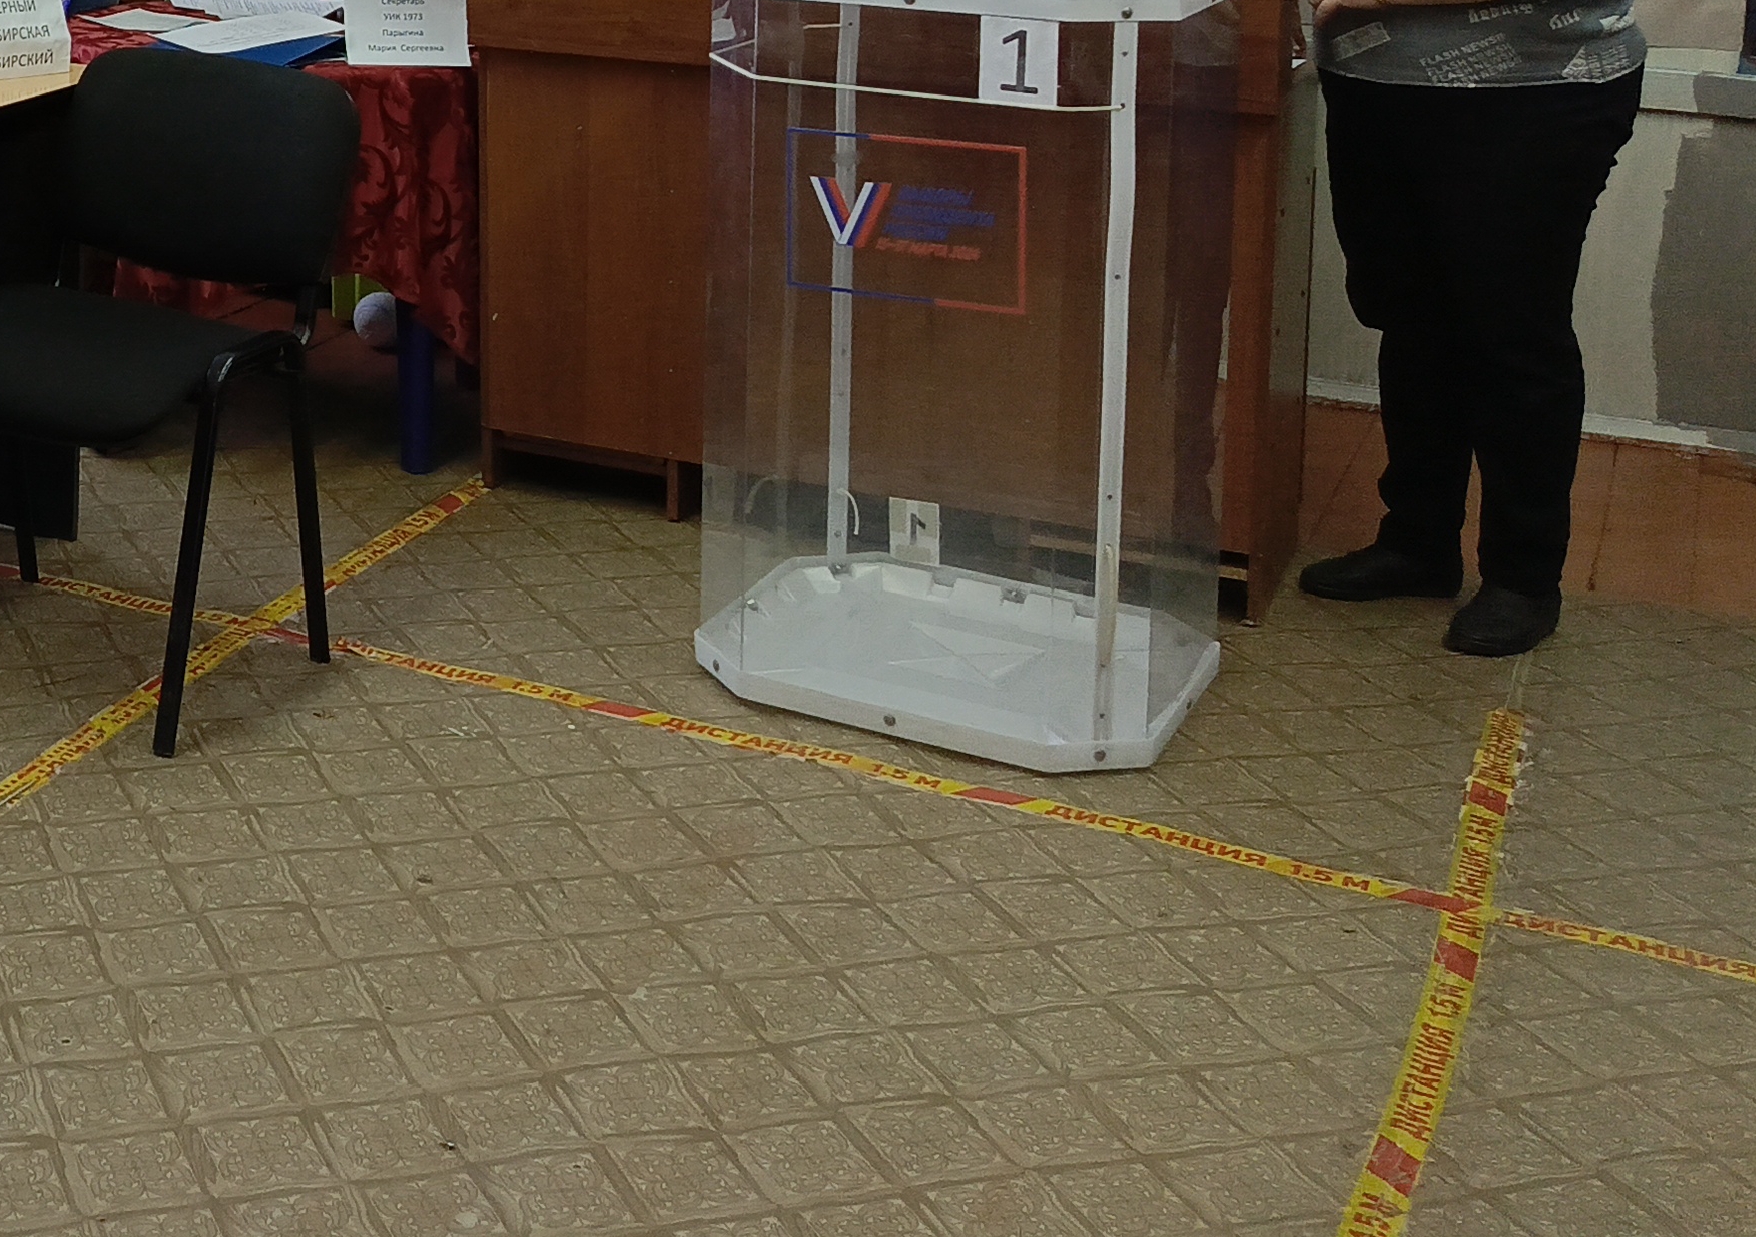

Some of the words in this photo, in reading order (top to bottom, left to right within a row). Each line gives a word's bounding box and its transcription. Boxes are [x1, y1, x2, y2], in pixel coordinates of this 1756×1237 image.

[383, 13, 401, 21] УИК
[403, 13, 423, 21] 1973
[400, 44, 444, 53] Сергеевна
[999, 29, 1039, 95] 1
[660, 717, 854, 764] ДИСТАНЦИЯ
[914, 775, 942, 790] М
[1045, 804, 1269, 867] ДИСТАНЦИЯ
[1341, 875, 1372, 893] М
[1389, 1021, 1456, 1143] ДИСТАНЦИЯ
